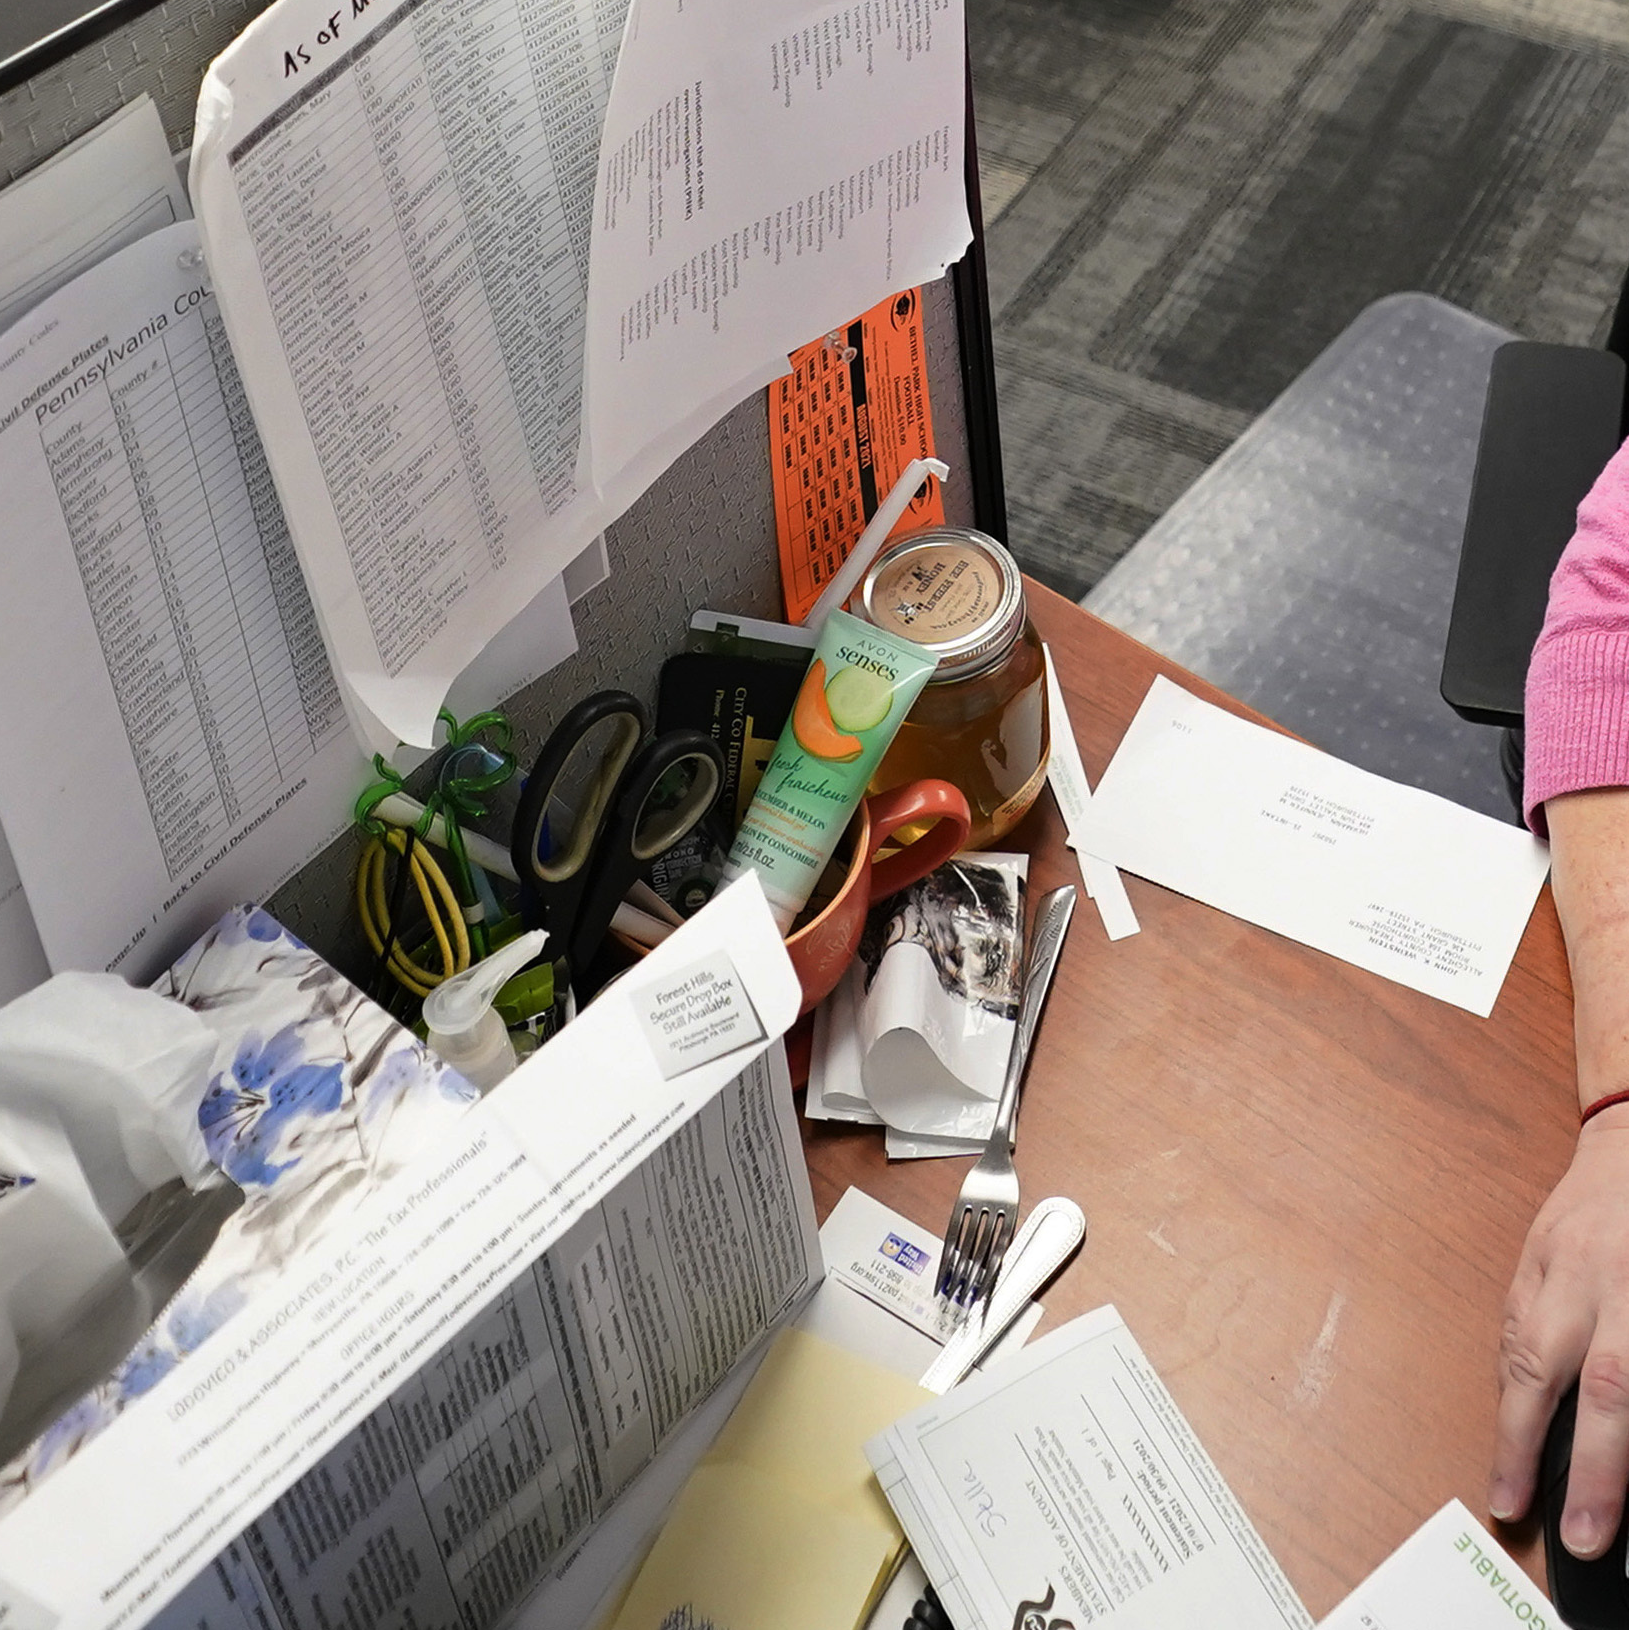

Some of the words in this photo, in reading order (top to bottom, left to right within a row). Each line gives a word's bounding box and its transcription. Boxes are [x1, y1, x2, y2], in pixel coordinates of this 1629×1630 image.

[273, 43, 312, 79] AS
[908, 325, 919, 366] BETHEL
[18, 364, 74, 411] Defense
[69, 332, 111, 370] Plates
[30, 310, 172, 426] Pennsylvania
[911, 365, 921, 393] PARK
[893, 375, 903, 415] Donation
[903, 374, 914, 427] FOOTBALL
[914, 393, 923, 421] HIGH
[855, 403, 868, 443] AUGUST
[917, 421, 927, 460] SCHOO
[49, 434, 85, 470] Adams
[53, 435, 105, 485] Allegheny
[57, 446, 113, 498] Armstrong
[859, 441, 871, 469] 2021
[914, 559, 946, 596] HONEY
[834, 642, 900, 683] senses
[855, 638, 899, 663] AVON
[227, 802, 274, 849] Defense
[273, 774, 307, 809] Plates
[648, 998, 688, 1025] Secure
[684, 986, 714, 1009] Drop
[711, 976, 733, 994] Box
[655, 979, 691, 1005] Forest
[688, 968, 715, 988] Hills
[660, 1013, 687, 1035] Still
[684, 993, 732, 1024] Available
[1097, 1455, 1119, 1481] Page
[1133, 1467, 1164, 1506] period:
[1023, 1477, 1061, 1532] ACCOUNT
[1053, 1530, 1070, 1550] OF
[1156, 1506, 1194, 1559] Statement
[1063, 1547, 1109, 1616] STATEMENT
[1450, 1530, 1547, 1630] GOTIABLE
